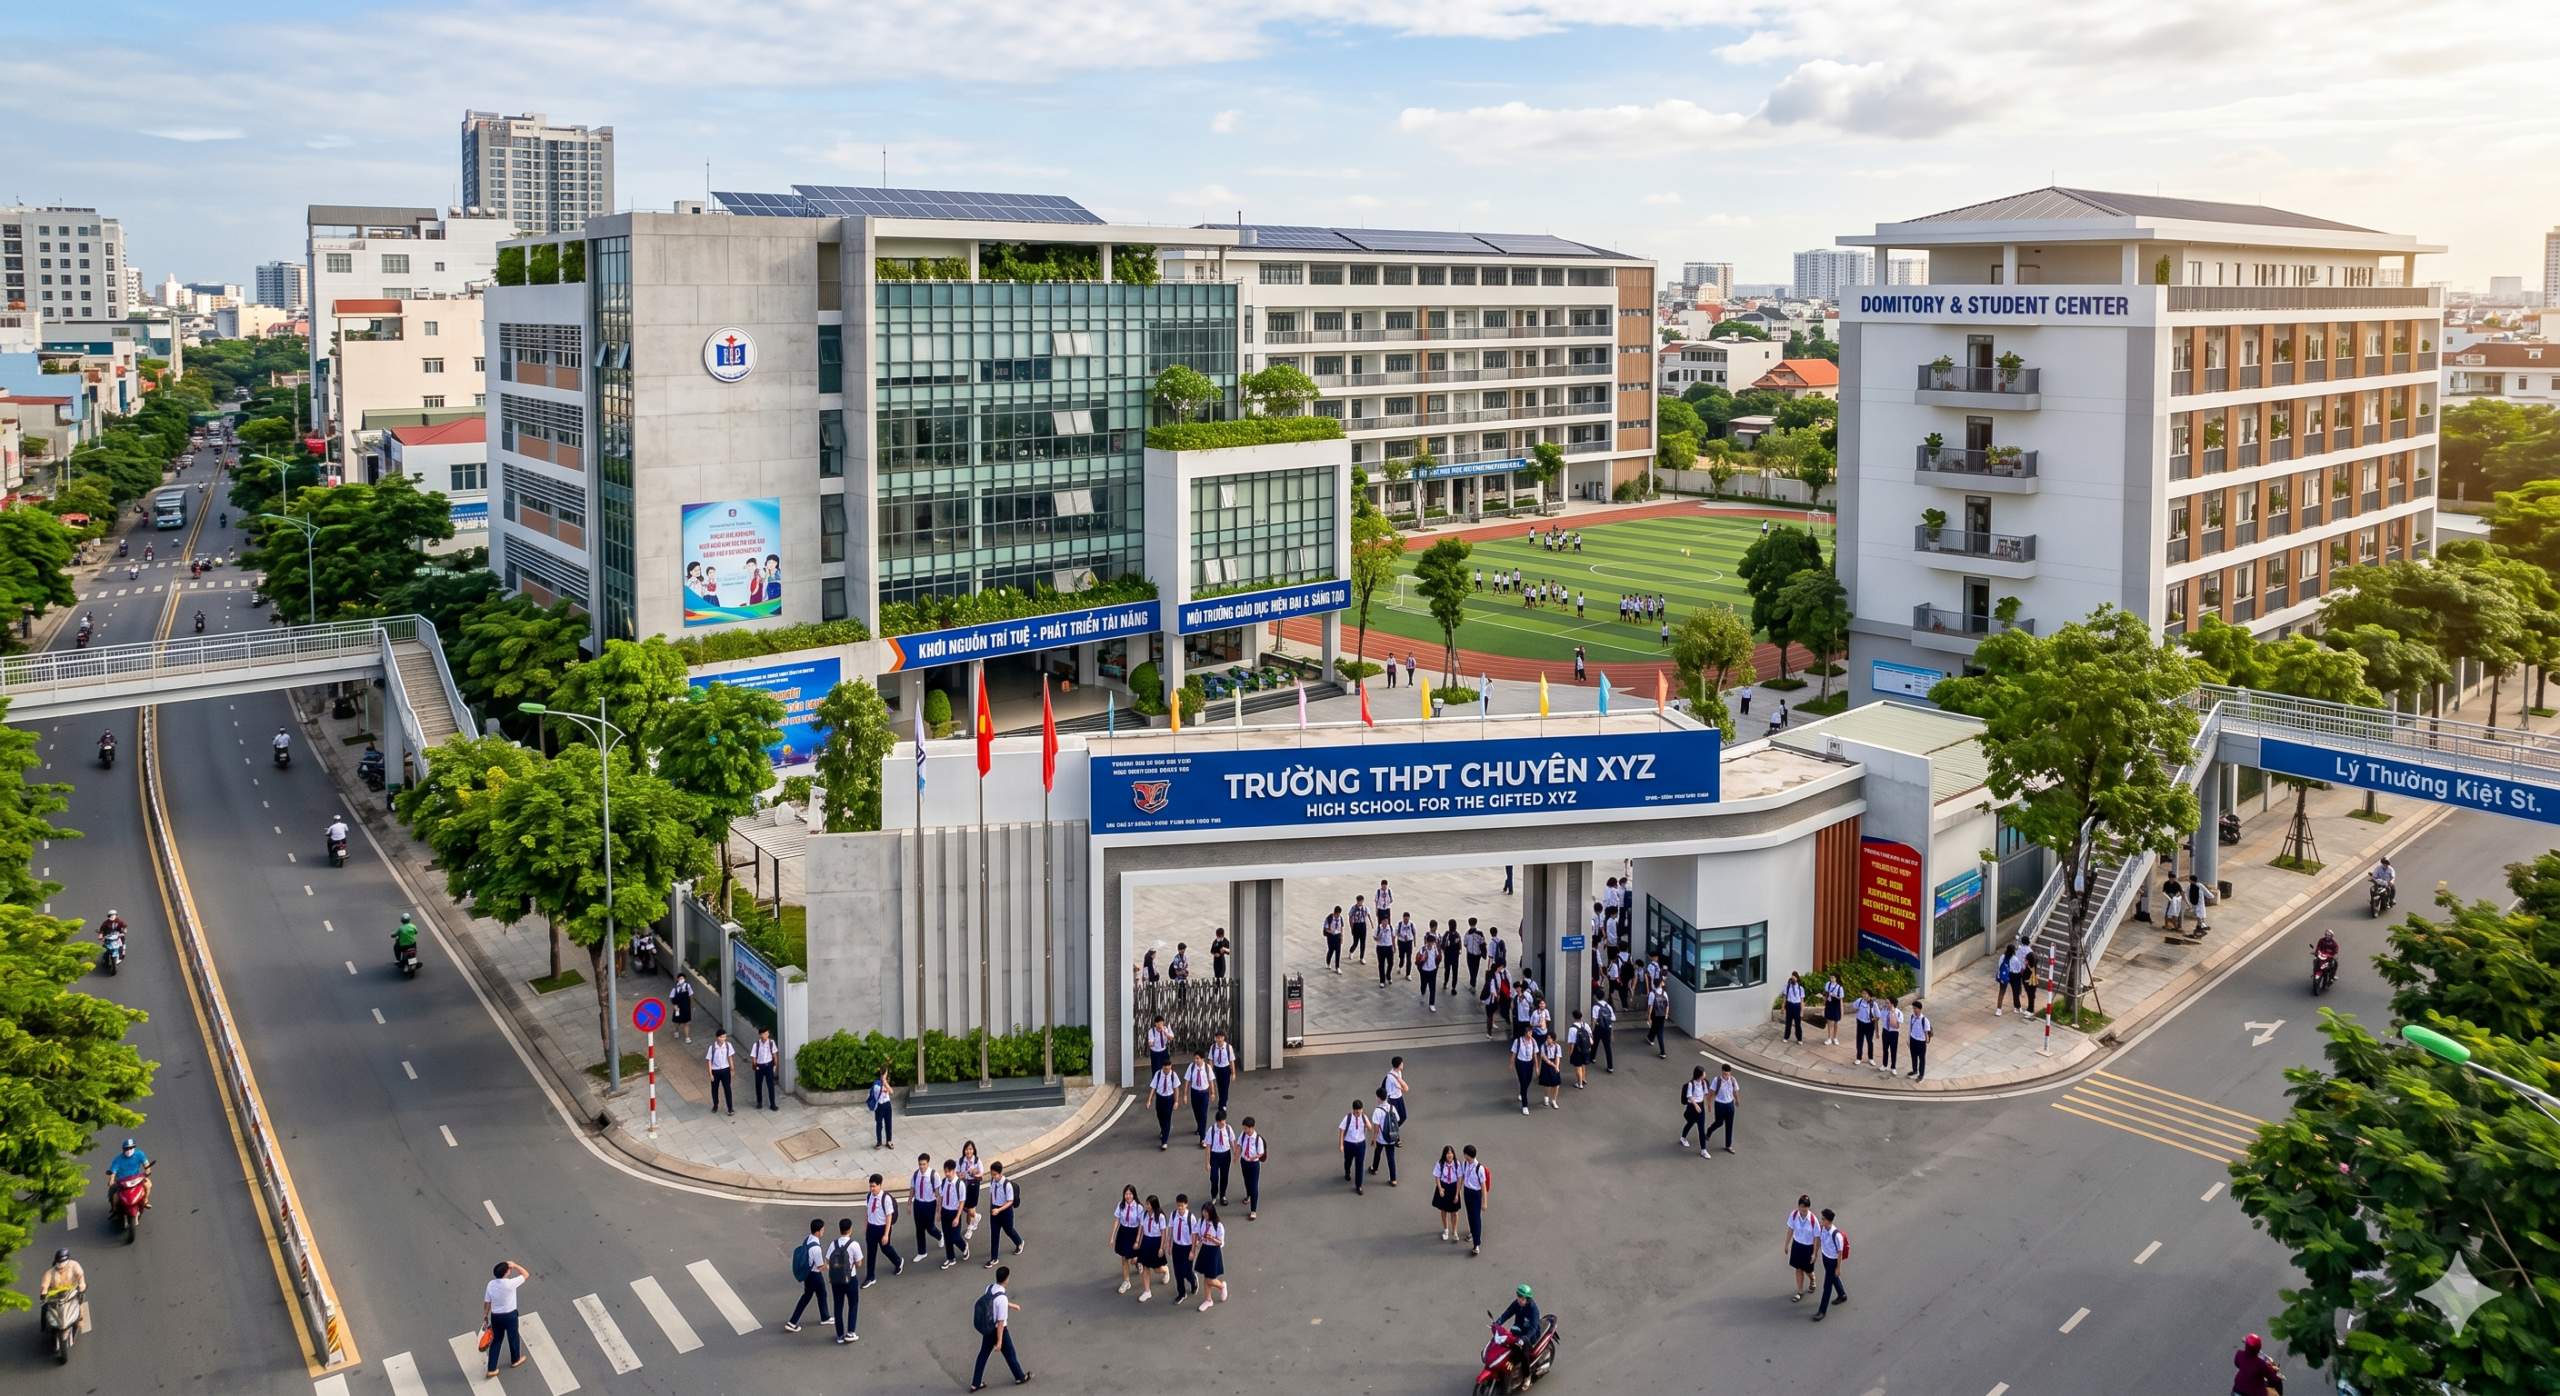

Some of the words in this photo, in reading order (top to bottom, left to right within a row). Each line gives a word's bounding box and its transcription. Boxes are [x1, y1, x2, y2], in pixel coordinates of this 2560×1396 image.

[1861, 295, 1945, 314] DOMITORY
[1950, 296, 1962, 313] &
[1967, 295, 2050, 315] STUDENT
[2055, 295, 2129, 315] CENTER
[1041, 621, 1067, 640] PHÁT
[1069, 612, 1100, 636] TRIỂN
[1102, 614, 1117, 630] TÀI
[1121, 610, 1147, 628] NĂNG
[1224, 765, 1359, 799] TRƯỜNG
[1370, 764, 1452, 792] THPT
[1460, 751, 1587, 791] CHUYÊN
[1597, 754, 1655, 781] XYZ
[2336, 757, 2360, 783] Lý
[2366, 762, 2448, 800] Thường
[2456, 778, 2502, 807] Kiệt
[2510, 788, 2542, 813] St.
[1307, 803, 1344, 816] HIGH
[1350, 799, 1414, 814] SCHOOL
[1420, 798, 1449, 811] FOR
[1455, 796, 1484, 809] THE
[1490, 793, 1543, 807] GIFTED
[1548, 791, 1576, 804] XYZ
